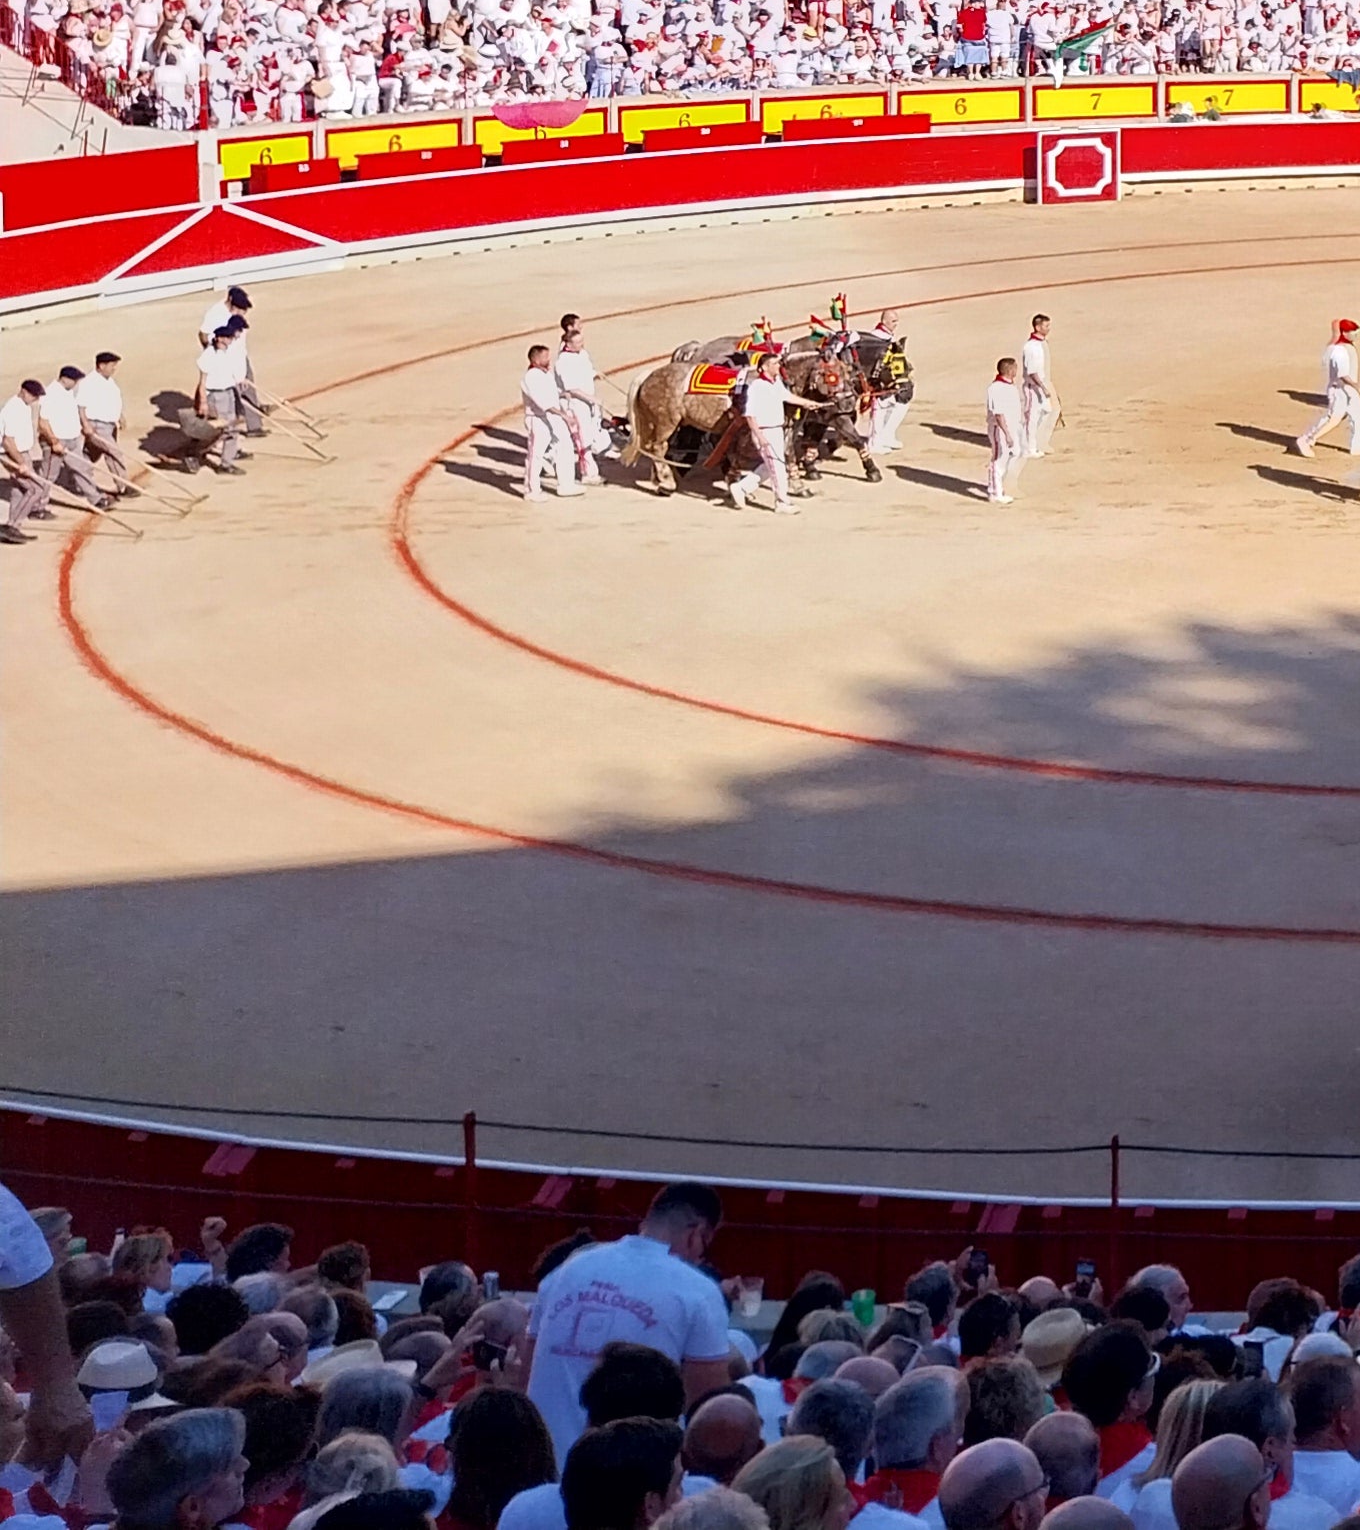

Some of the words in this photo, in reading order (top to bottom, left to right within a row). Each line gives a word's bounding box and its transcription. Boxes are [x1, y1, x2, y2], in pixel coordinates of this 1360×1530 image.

[955, 97, 967, 115] 6
[1090, 93, 1101, 110] 7
[1223, 89, 1234, 106] 7
[389, 135, 402, 152] 6
[260, 147, 272, 165] 6
